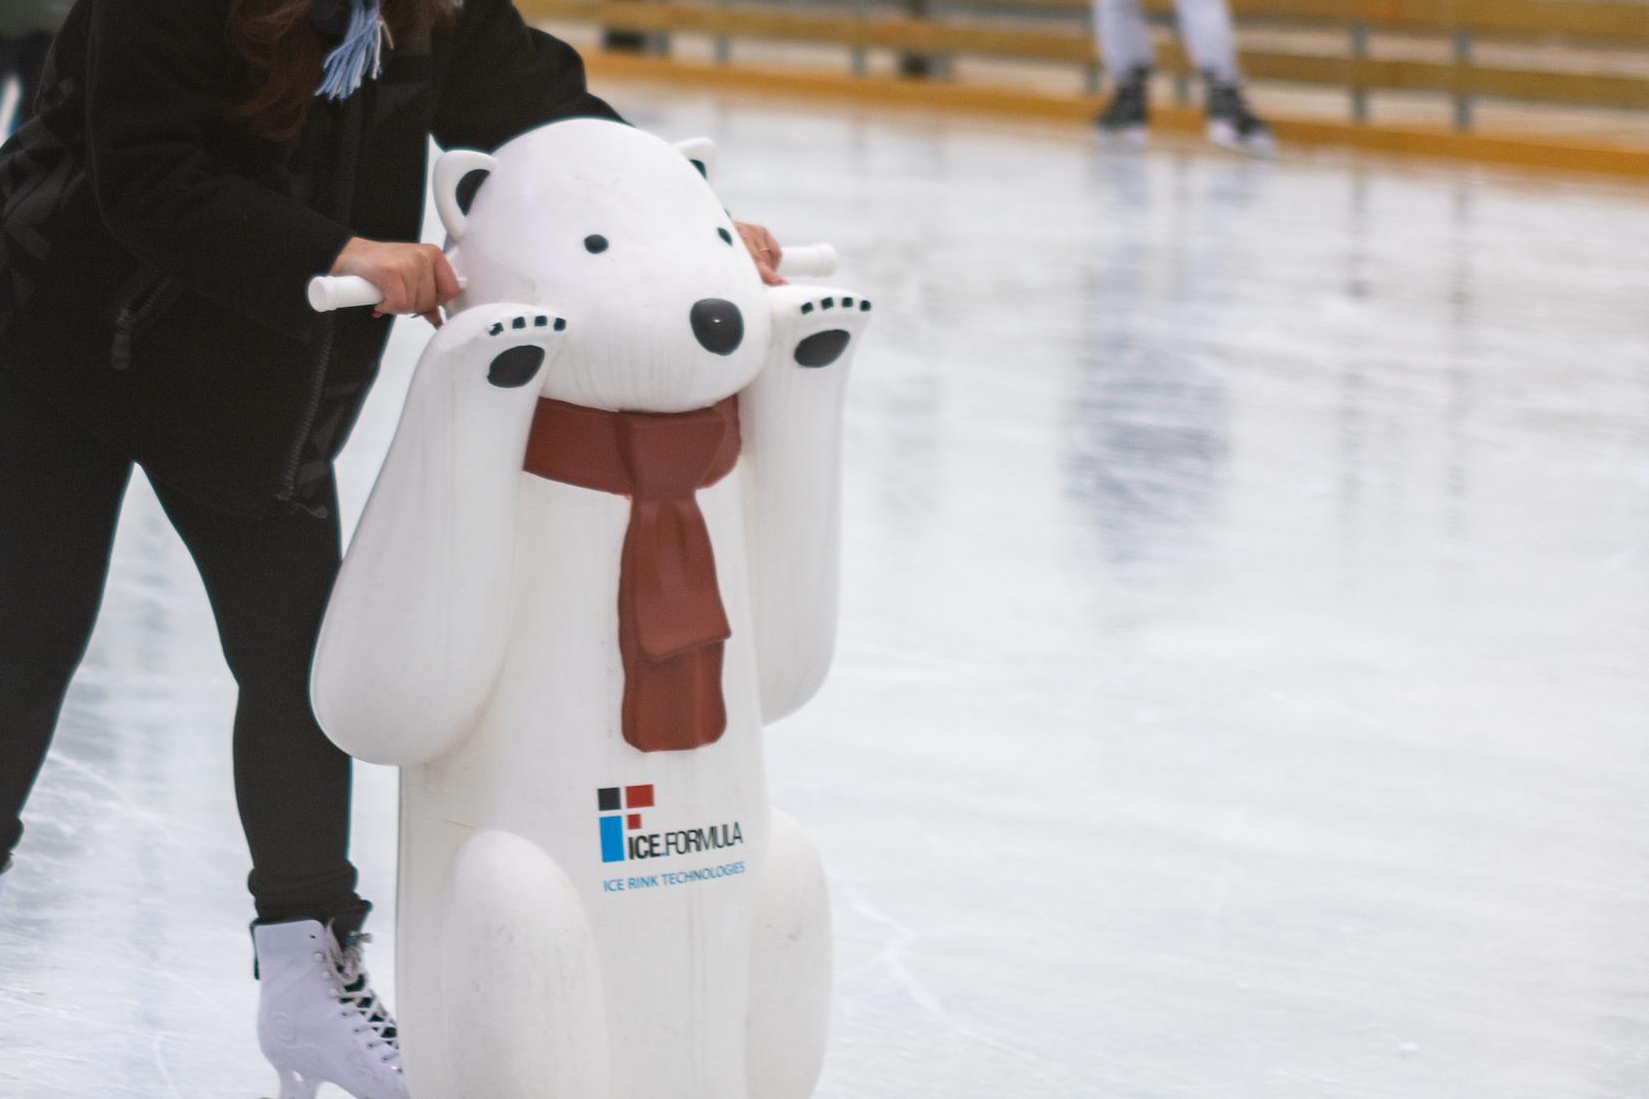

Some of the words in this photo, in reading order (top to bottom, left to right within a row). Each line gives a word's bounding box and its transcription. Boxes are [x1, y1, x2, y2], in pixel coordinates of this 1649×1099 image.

[628, 821, 743, 860] ICE.FORMULA
[603, 878, 625, 893] ICE
[628, 875, 659, 890] RINK
[662, 861, 746, 885] TECHNOLOGIES
